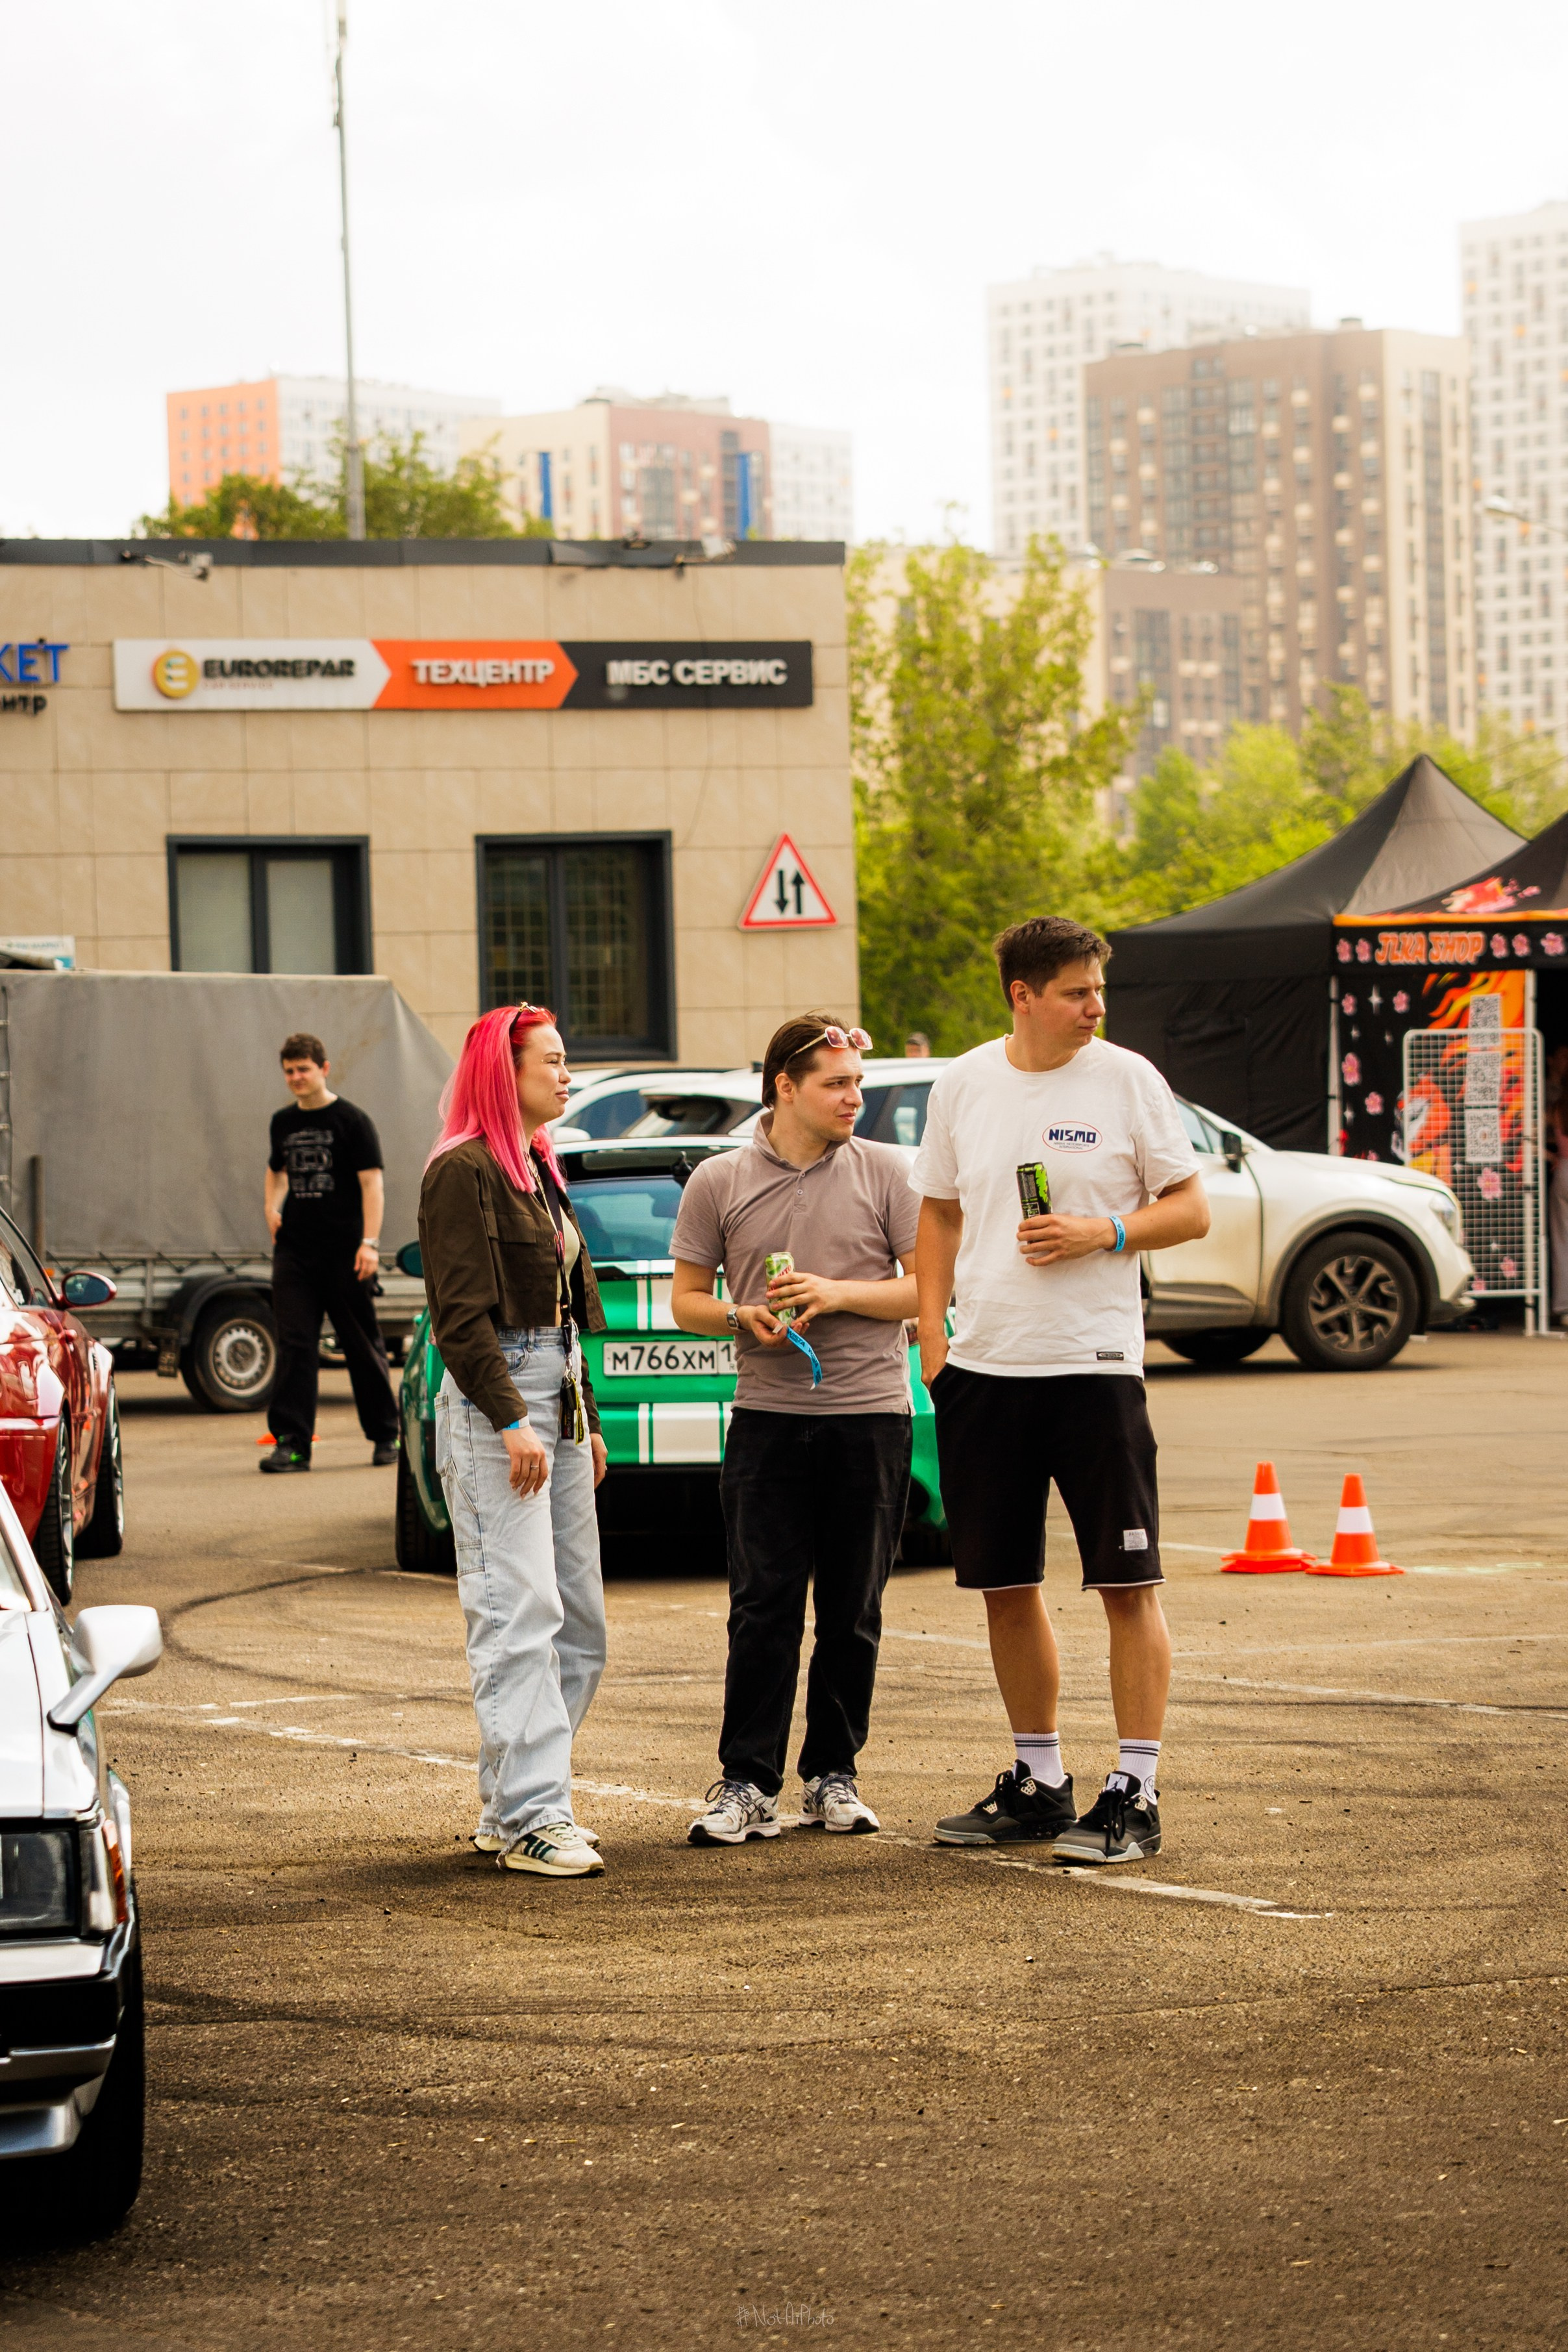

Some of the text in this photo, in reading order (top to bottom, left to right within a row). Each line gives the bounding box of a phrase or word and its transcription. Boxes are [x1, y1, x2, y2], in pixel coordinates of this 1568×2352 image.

[204, 660, 355, 678] EUROREPAR
[413, 660, 554, 687] ТЕХЦЕНТР
[607, 659, 788, 685] МБС СЕРВИС
[1429, 932, 1486, 965] SHOP
[1049, 1129, 1097, 1144] NISMO
